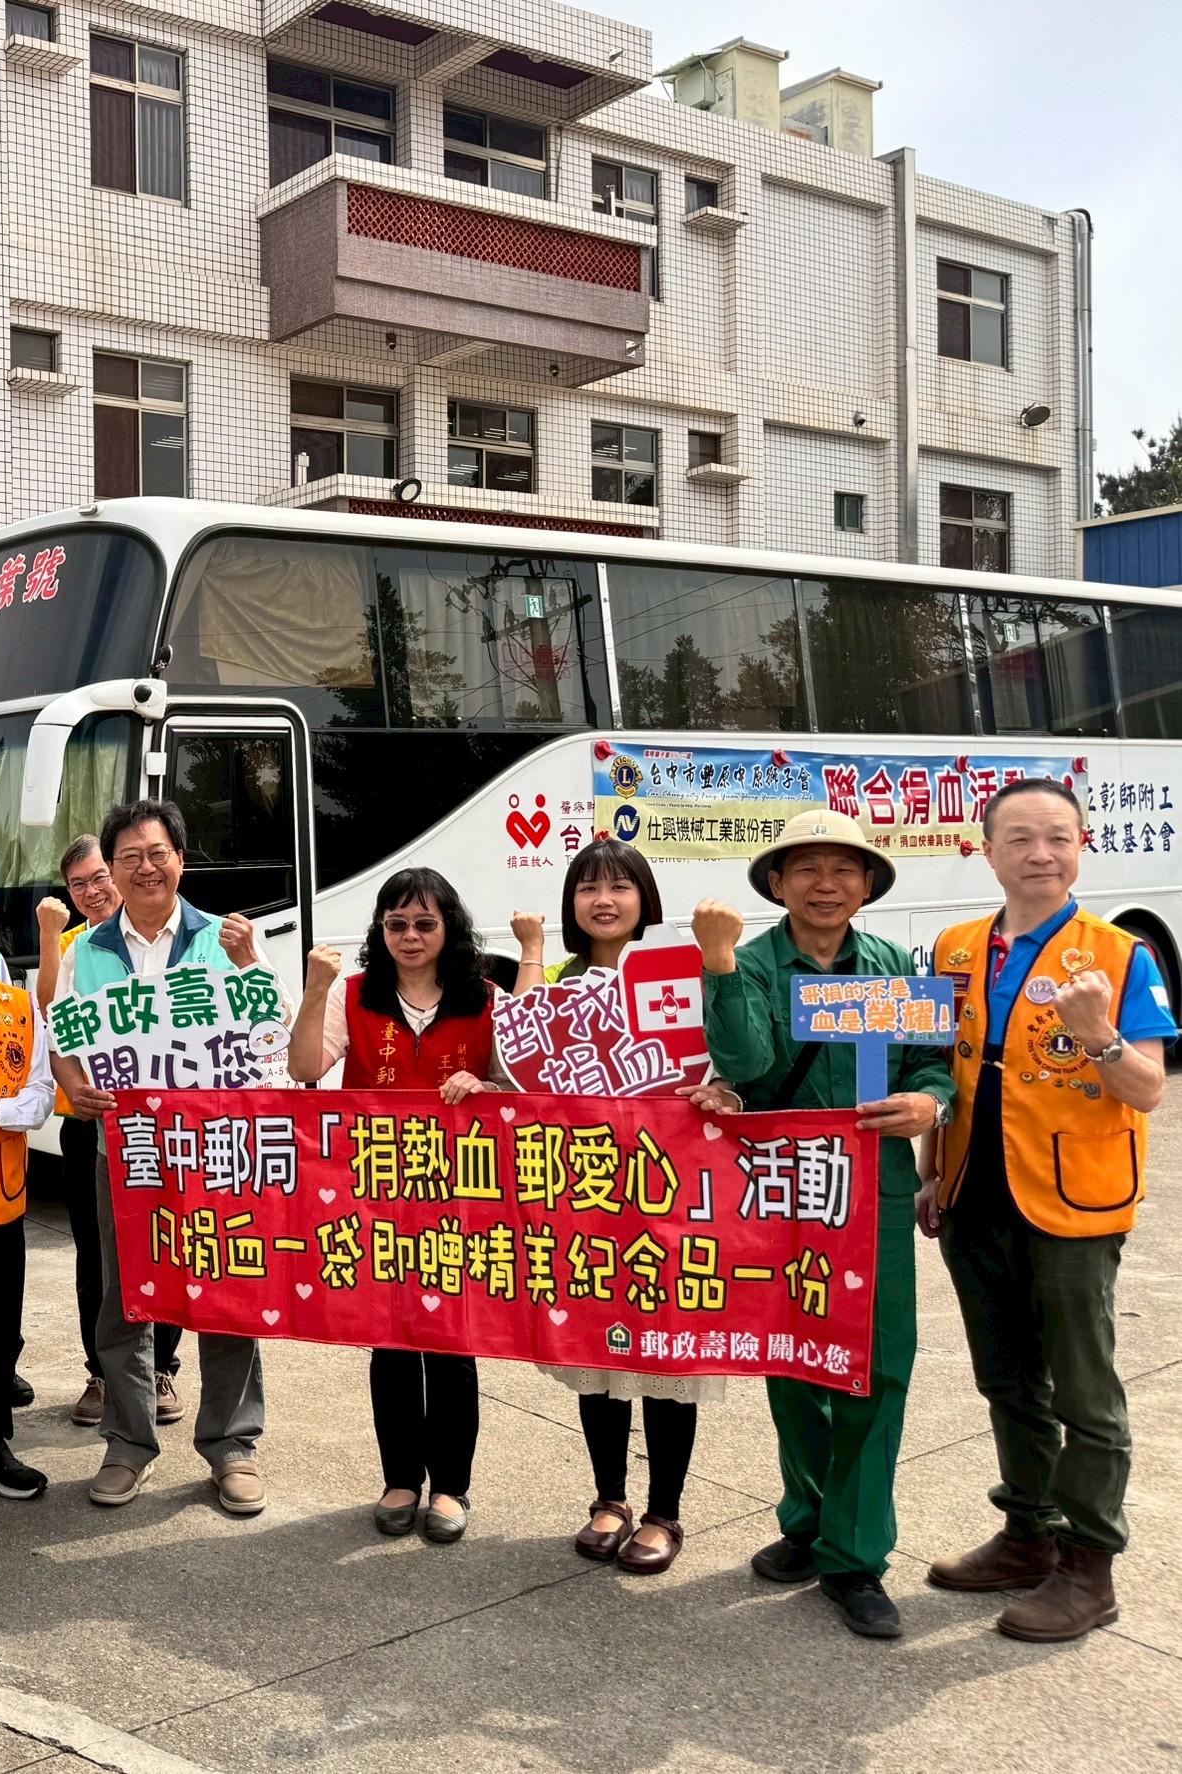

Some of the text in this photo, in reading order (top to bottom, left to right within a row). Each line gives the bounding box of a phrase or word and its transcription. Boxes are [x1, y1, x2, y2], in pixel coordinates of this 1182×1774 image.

[650, 762, 812, 791] 台中市豐原中原獅子會
[51, 966, 282, 1053] 郵政壽險
[800, 979, 910, 1004] 哥捐的不是
[811, 999, 951, 1032] 血是榮耀!
[541, 1037, 680, 1096] 捐血
[149, 1204, 833, 1318] 凡捐血一袋即贈精美紀念品一份
[640, 1329, 852, 1375] 郵政壽險 關心您
